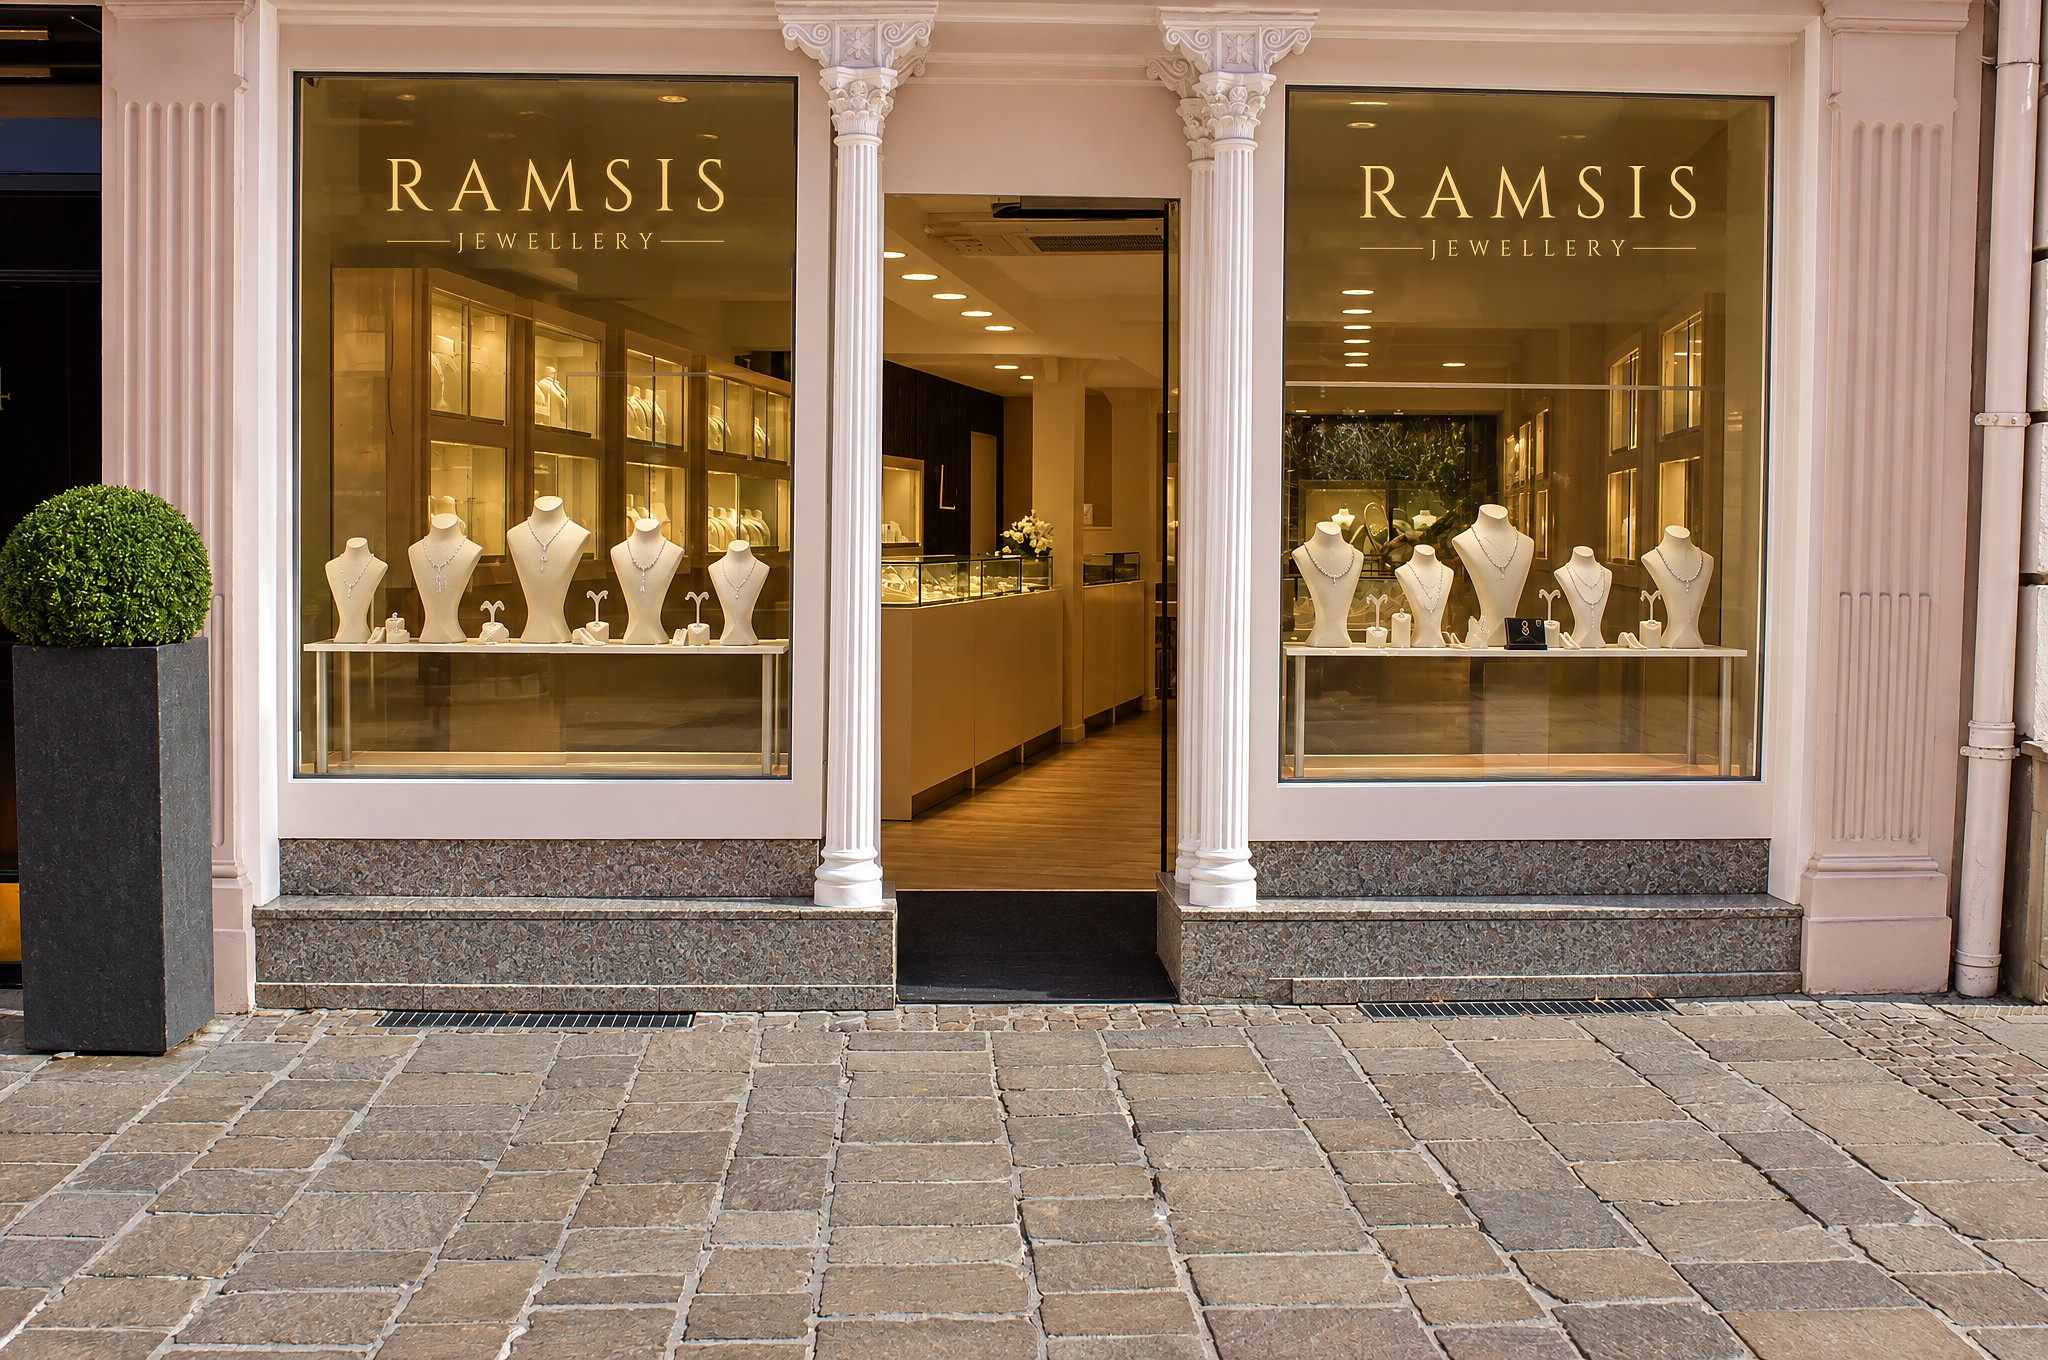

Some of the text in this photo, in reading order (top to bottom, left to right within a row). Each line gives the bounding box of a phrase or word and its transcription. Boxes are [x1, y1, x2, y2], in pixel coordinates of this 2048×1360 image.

[386, 158, 725, 212] RAMSIS
[1359, 165, 1697, 219] RAMSIS
[457, 232, 653, 254] JEWELLERY
[1430, 239, 1626, 261] JEWELLERY
